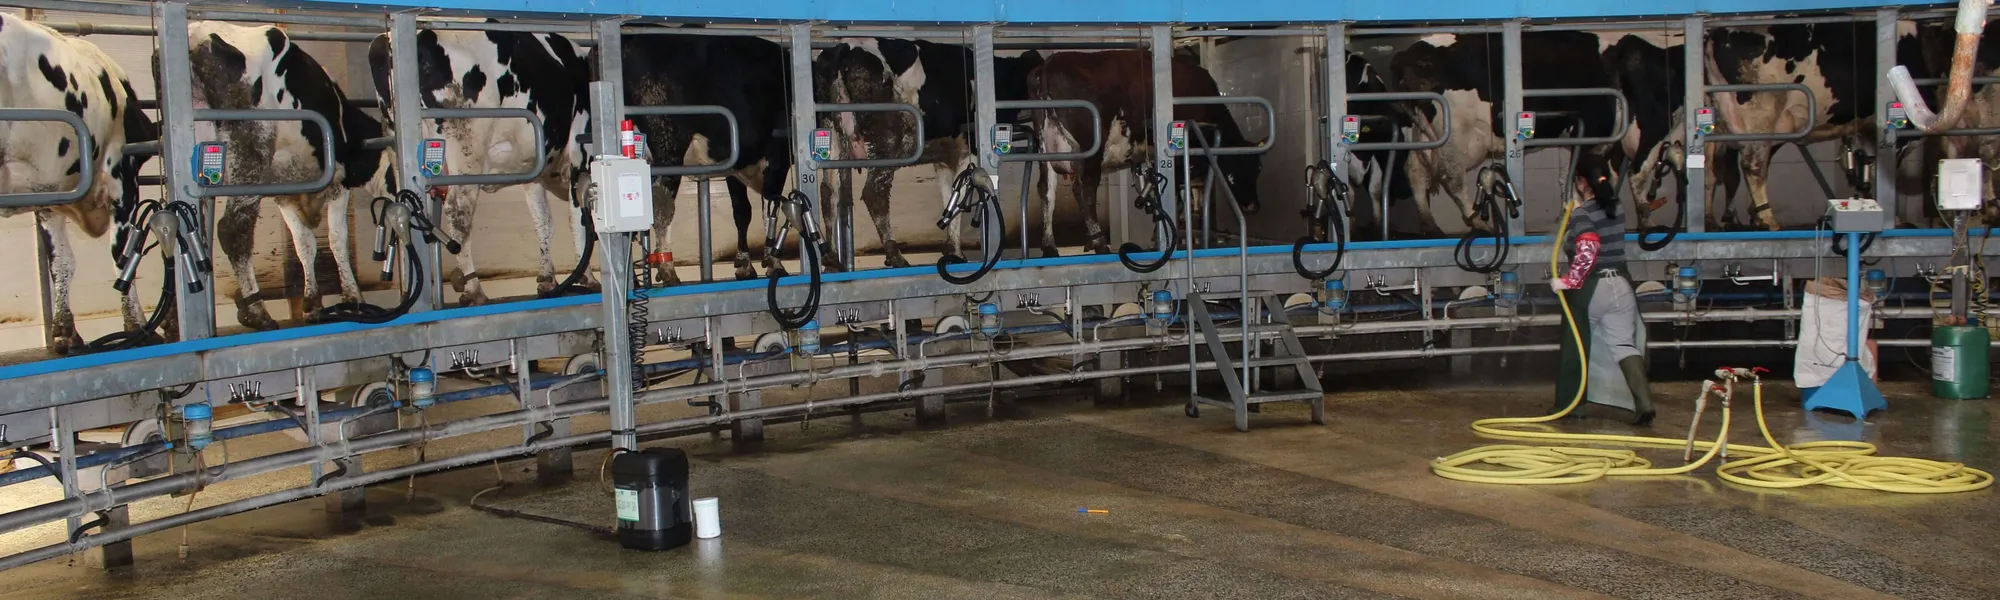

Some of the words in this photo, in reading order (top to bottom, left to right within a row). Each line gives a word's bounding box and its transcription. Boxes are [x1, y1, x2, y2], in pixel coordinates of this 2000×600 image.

[1509, 149, 1522, 158] 26
[1160, 159, 1173, 169] 28
[802, 173, 815, 184] 30
